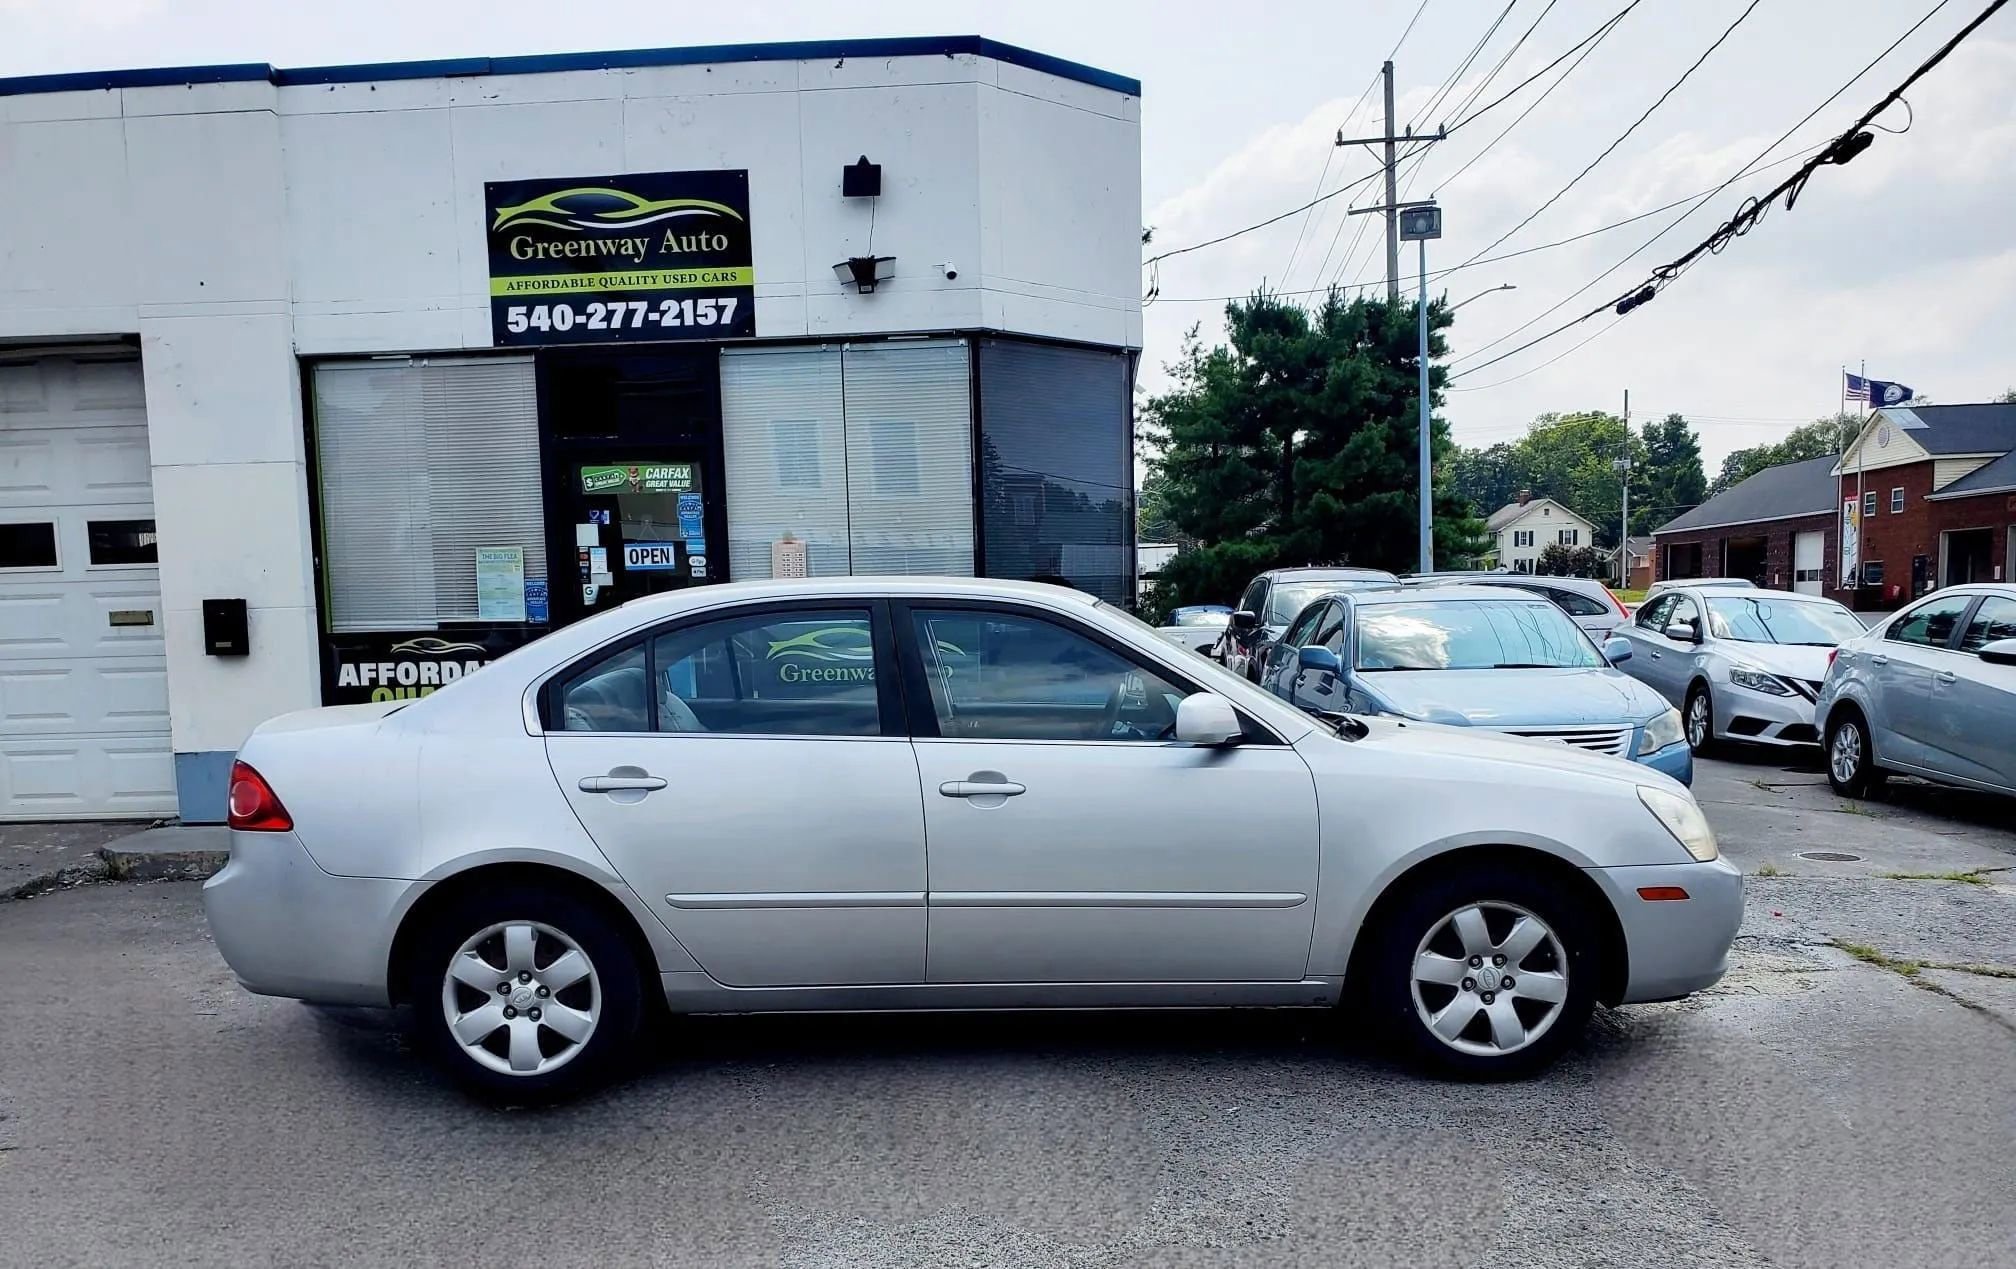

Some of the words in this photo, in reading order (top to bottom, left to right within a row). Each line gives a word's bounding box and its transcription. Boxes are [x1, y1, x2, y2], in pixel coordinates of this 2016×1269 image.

[509, 235, 651, 264] Greenway
[658, 227, 729, 254] Auto
[506, 275, 596, 291] AFFORDABLE
[598, 274, 660, 288] QUALITY
[662, 272, 698, 284] USED
[701, 270, 738, 283] CARS
[506, 297, 738, 334] 540-277-2157
[645, 467, 690, 479] CARFAX
[645, 480, 668, 488] GREAT
[669, 479, 691, 488] VALUE
[629, 548, 670, 565] OPEN
[338, 660, 494, 686] AFFORDA
[780, 662, 876, 682] Greenwa
